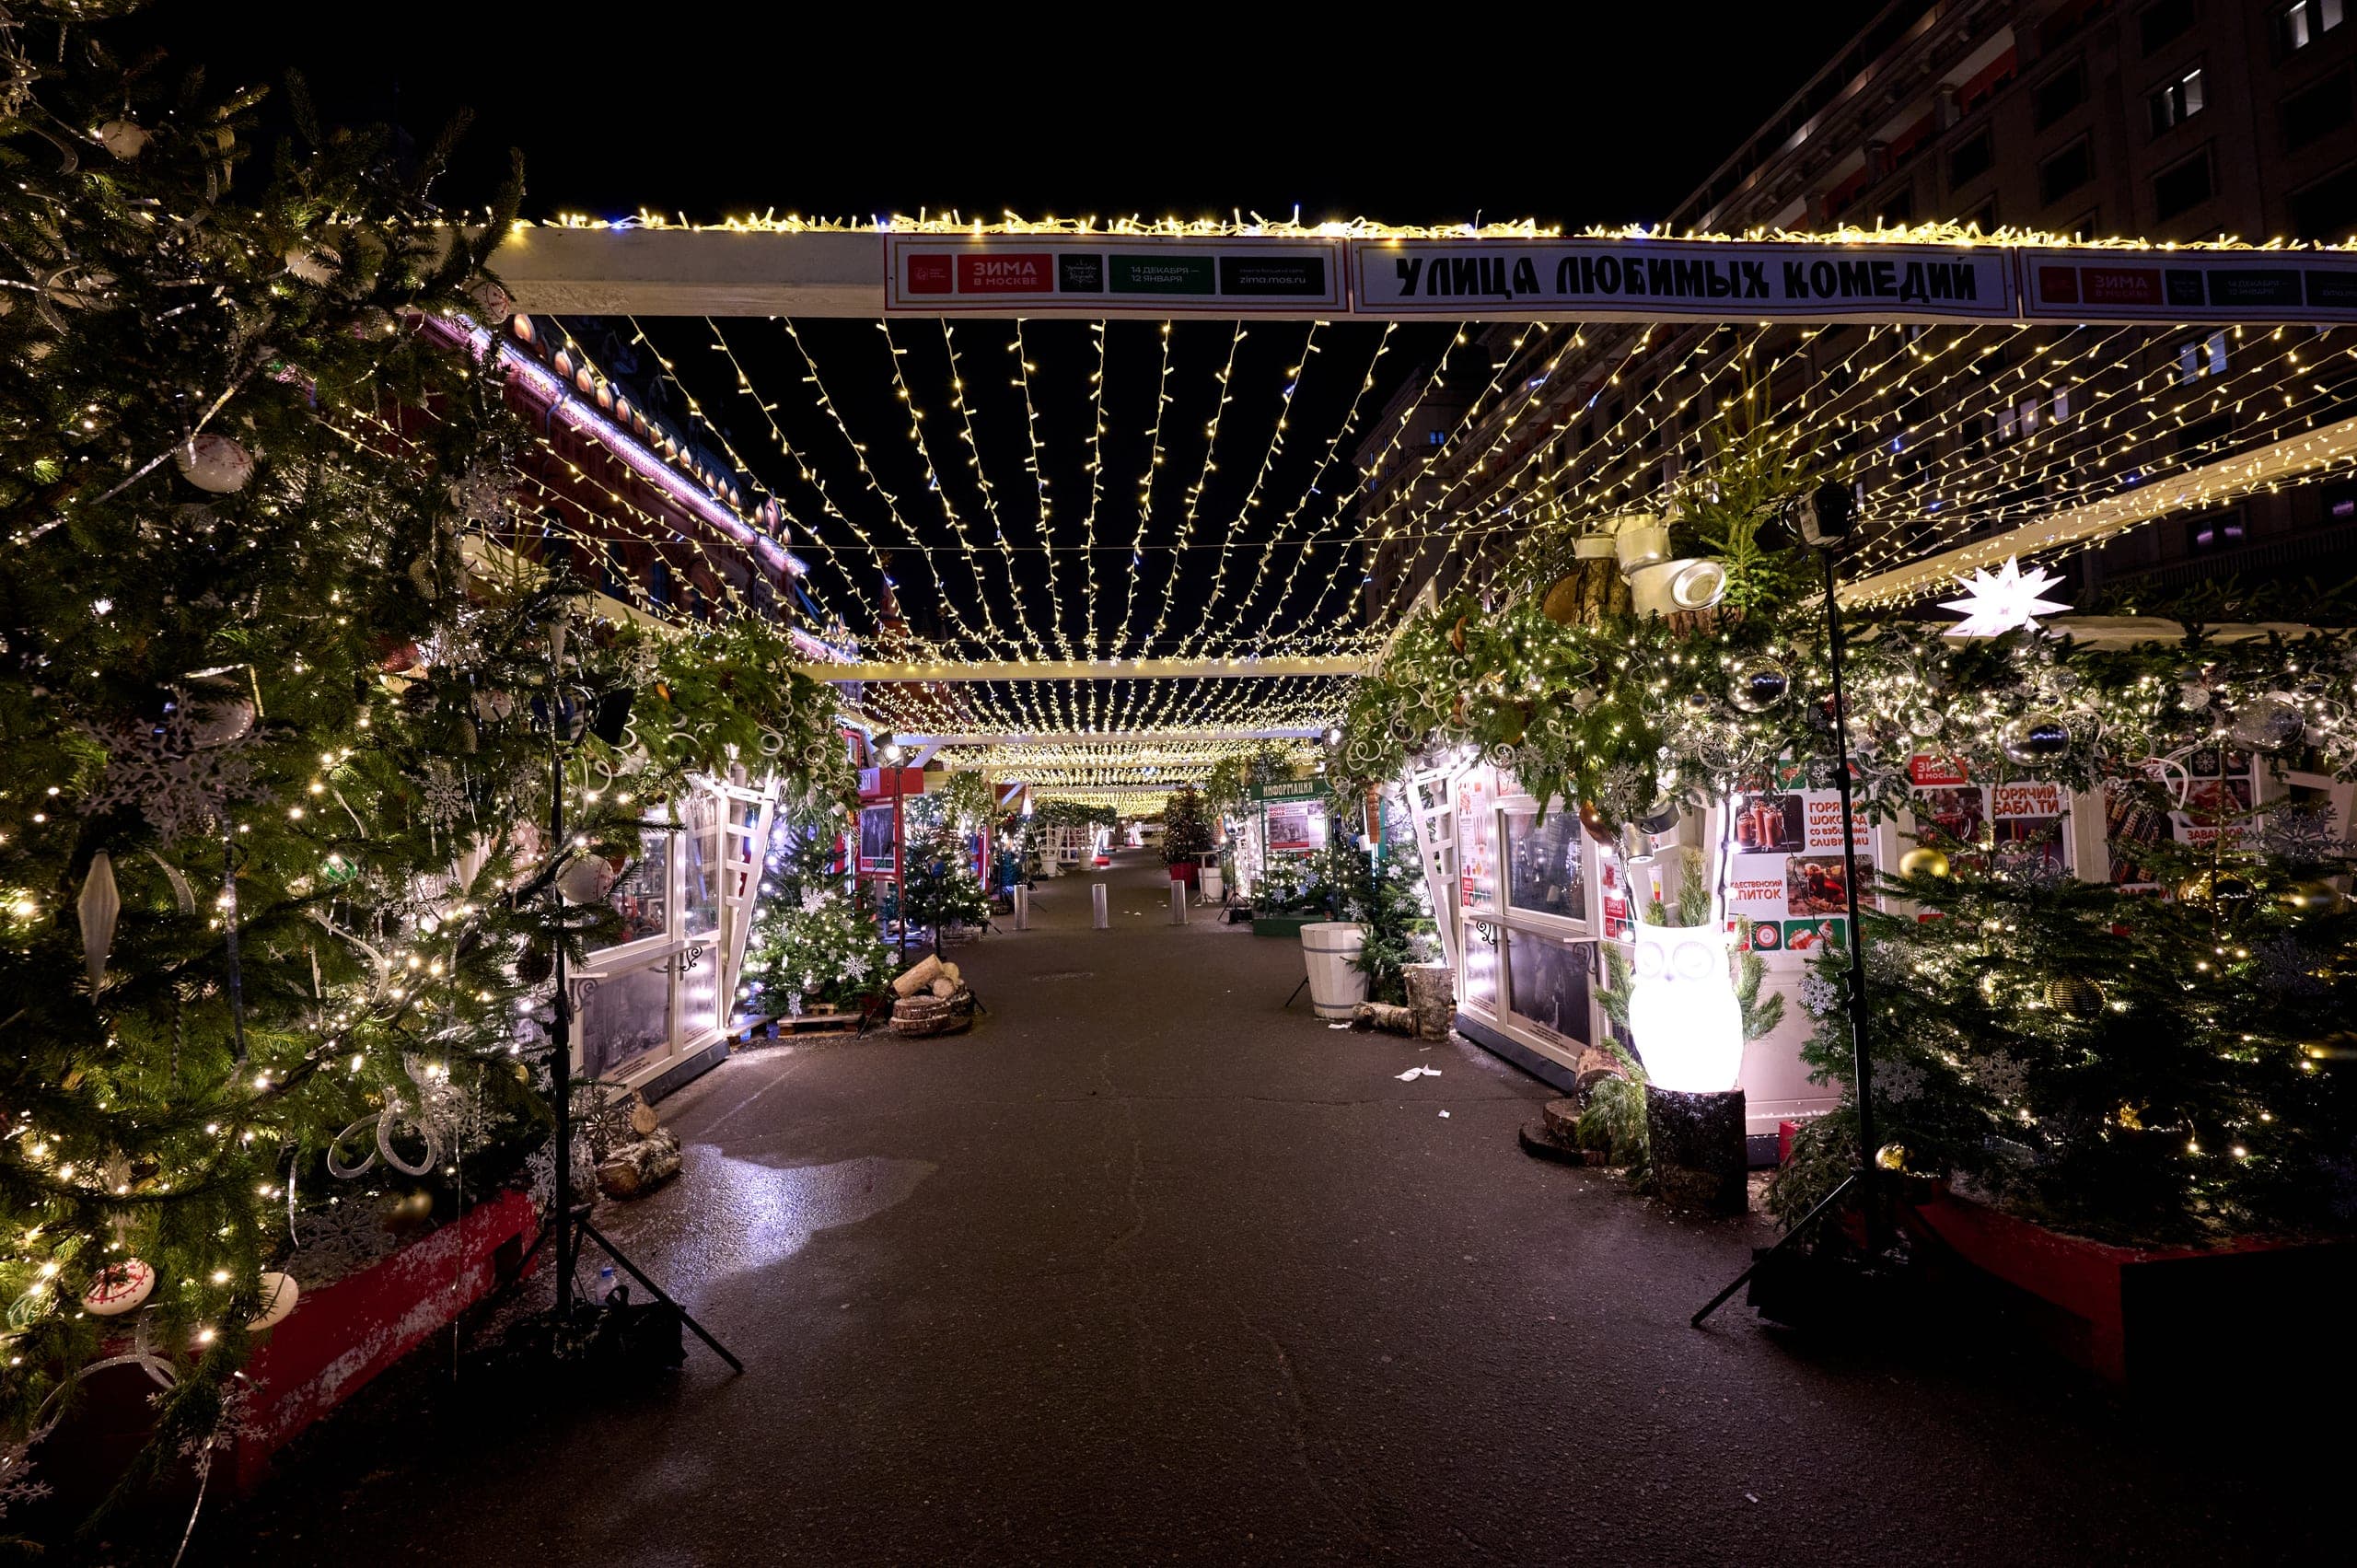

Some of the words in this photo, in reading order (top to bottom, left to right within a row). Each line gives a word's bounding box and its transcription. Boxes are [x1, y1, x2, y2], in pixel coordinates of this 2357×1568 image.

[973, 261, 1038, 276] ЗИМА
[1142, 266, 1189, 274] ДЕКАБРЯ
[973, 277, 981, 285] В
[986, 276, 1039, 285] МОСКВЕ
[1143, 274, 1183, 283] ЯНВАРЯ
[1239, 275, 1306, 285] zima.mos.ru
[1396, 257, 1540, 299] УЛИЦА
[1556, 255, 1770, 299] ЛЮБИМЫХ
[1784, 255, 1978, 302] КОМЕДИЙ
[2093, 273, 2149, 289] ЗИМА
[1263, 782, 1313, 796] ИНФОРМАЦИЯ
[1809, 800, 1864, 813] ГОРЯИ
[1993, 800, 2035, 815] БАБЛ
[2037, 799, 2060, 814] ТИ
[1810, 815, 1867, 825] ШОКОАД
[1822, 826, 1868, 835] взбими
[1810, 837, 1869, 846] сливкми
[1731, 889, 1782, 900] ПИТОК
